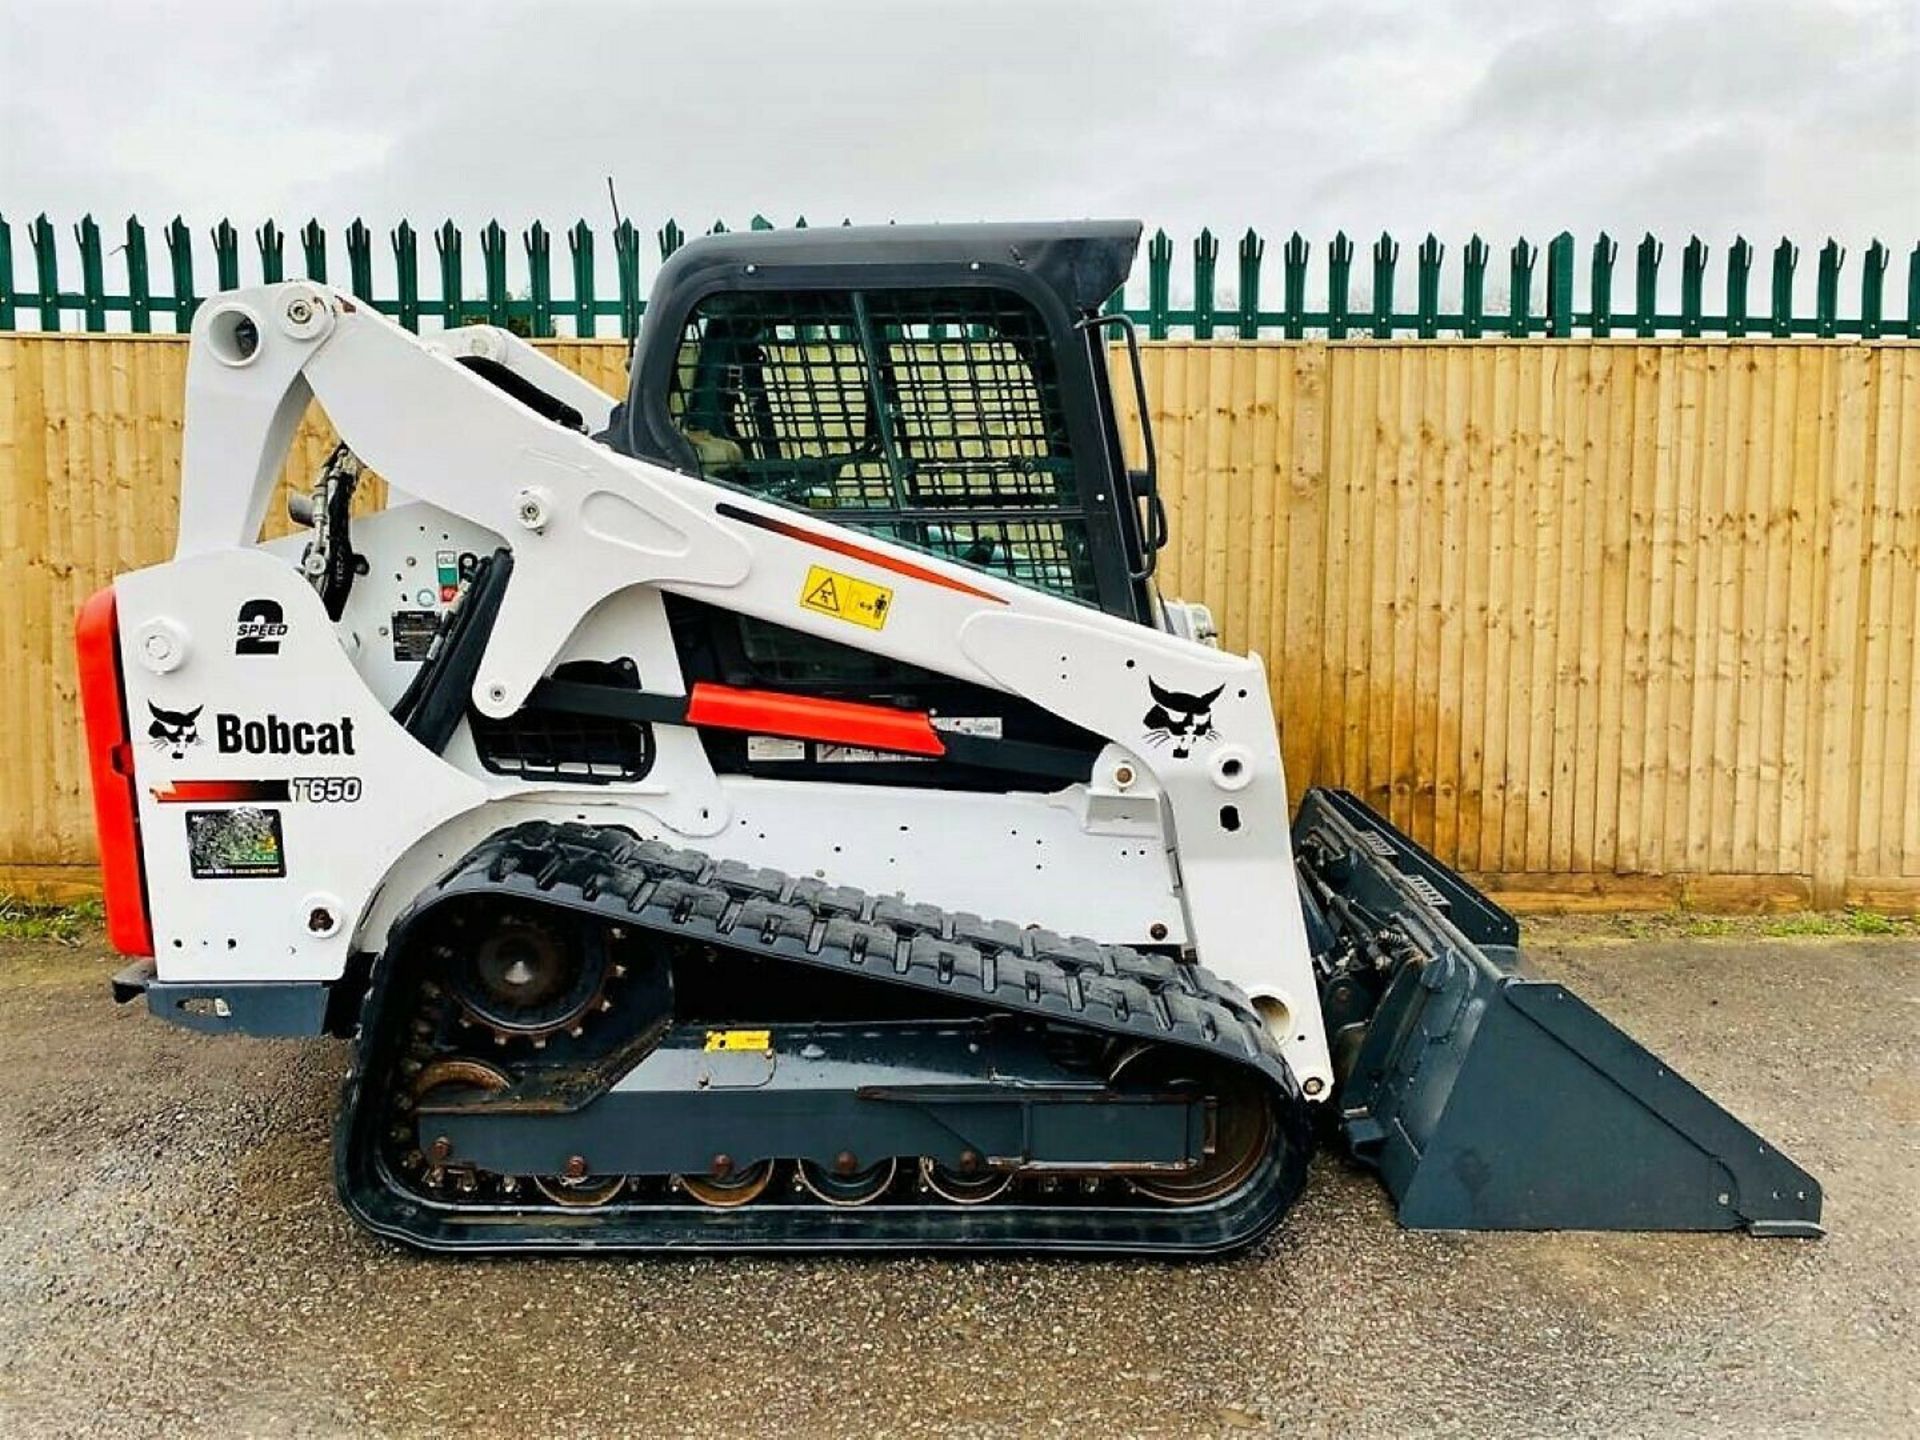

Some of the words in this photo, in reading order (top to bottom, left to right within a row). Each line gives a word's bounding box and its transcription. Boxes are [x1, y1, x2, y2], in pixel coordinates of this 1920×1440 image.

[235, 599, 284, 655] 2
[236, 623, 288, 637] SPEED
[216, 713, 355, 756] Bobcat
[293, 778, 362, 803] T650
